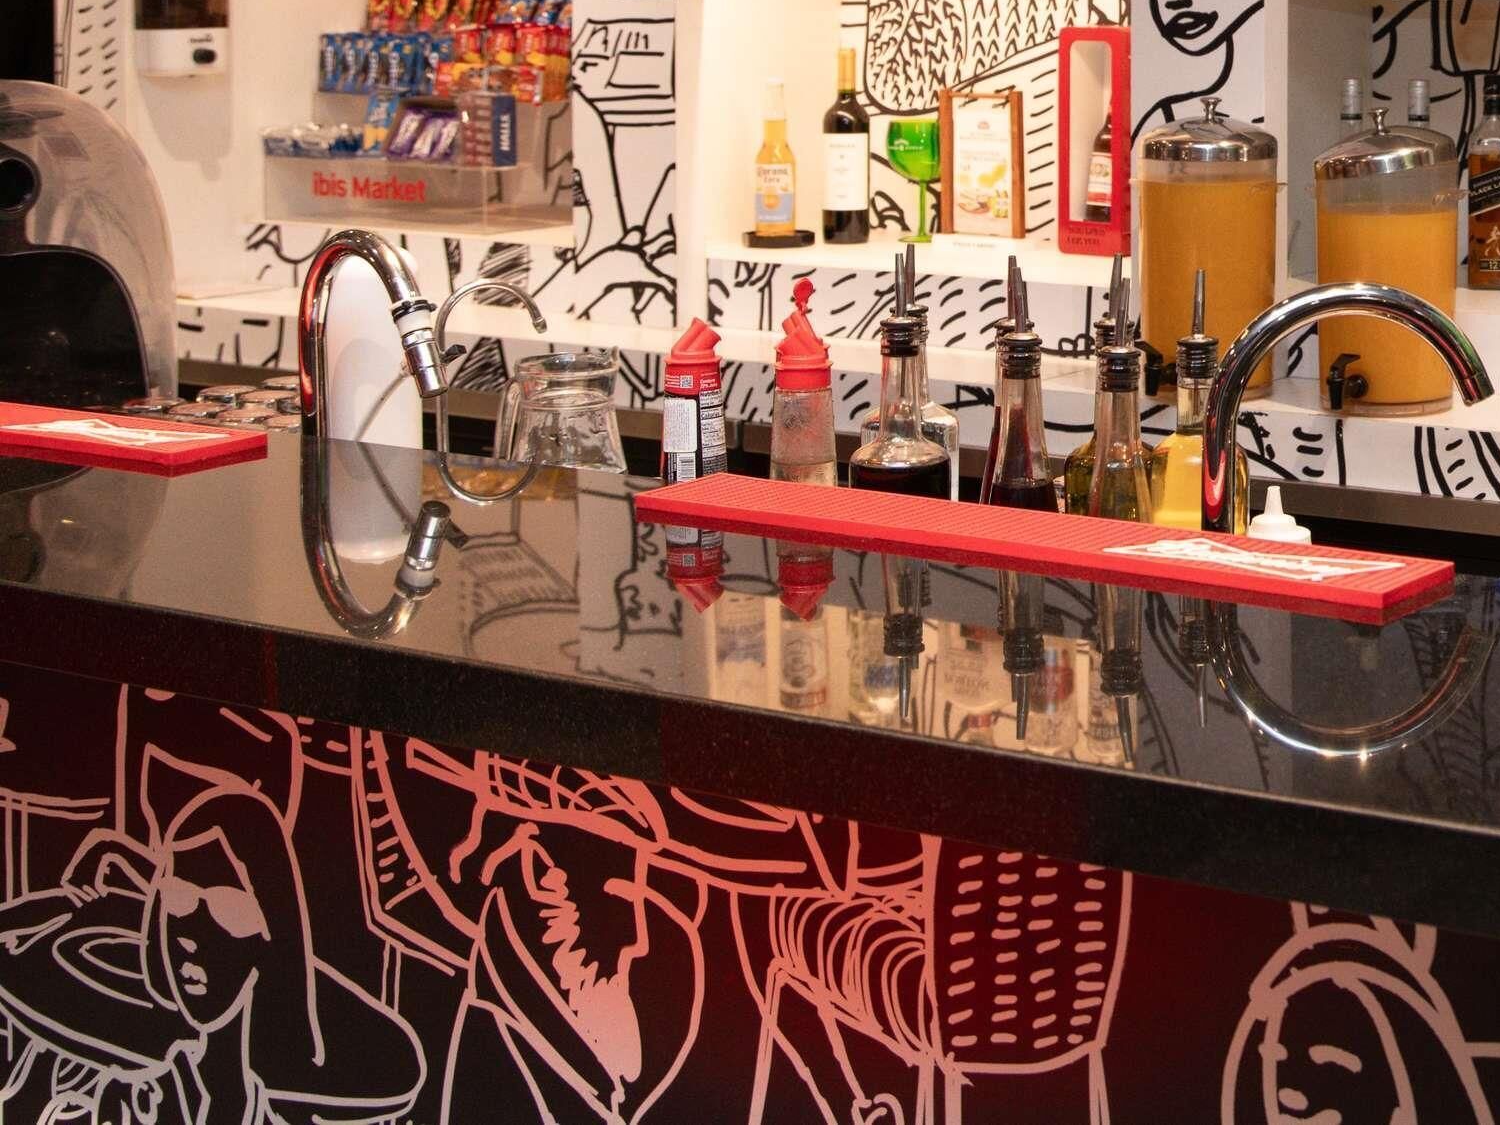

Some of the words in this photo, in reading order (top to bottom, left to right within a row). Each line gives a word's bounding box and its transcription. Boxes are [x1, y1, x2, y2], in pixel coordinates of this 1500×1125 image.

[501, 114, 511, 152] HALLS
[312, 171, 347, 198] ibis
[353, 176, 426, 203] Market
[1489, 260, 1499, 270] 12
